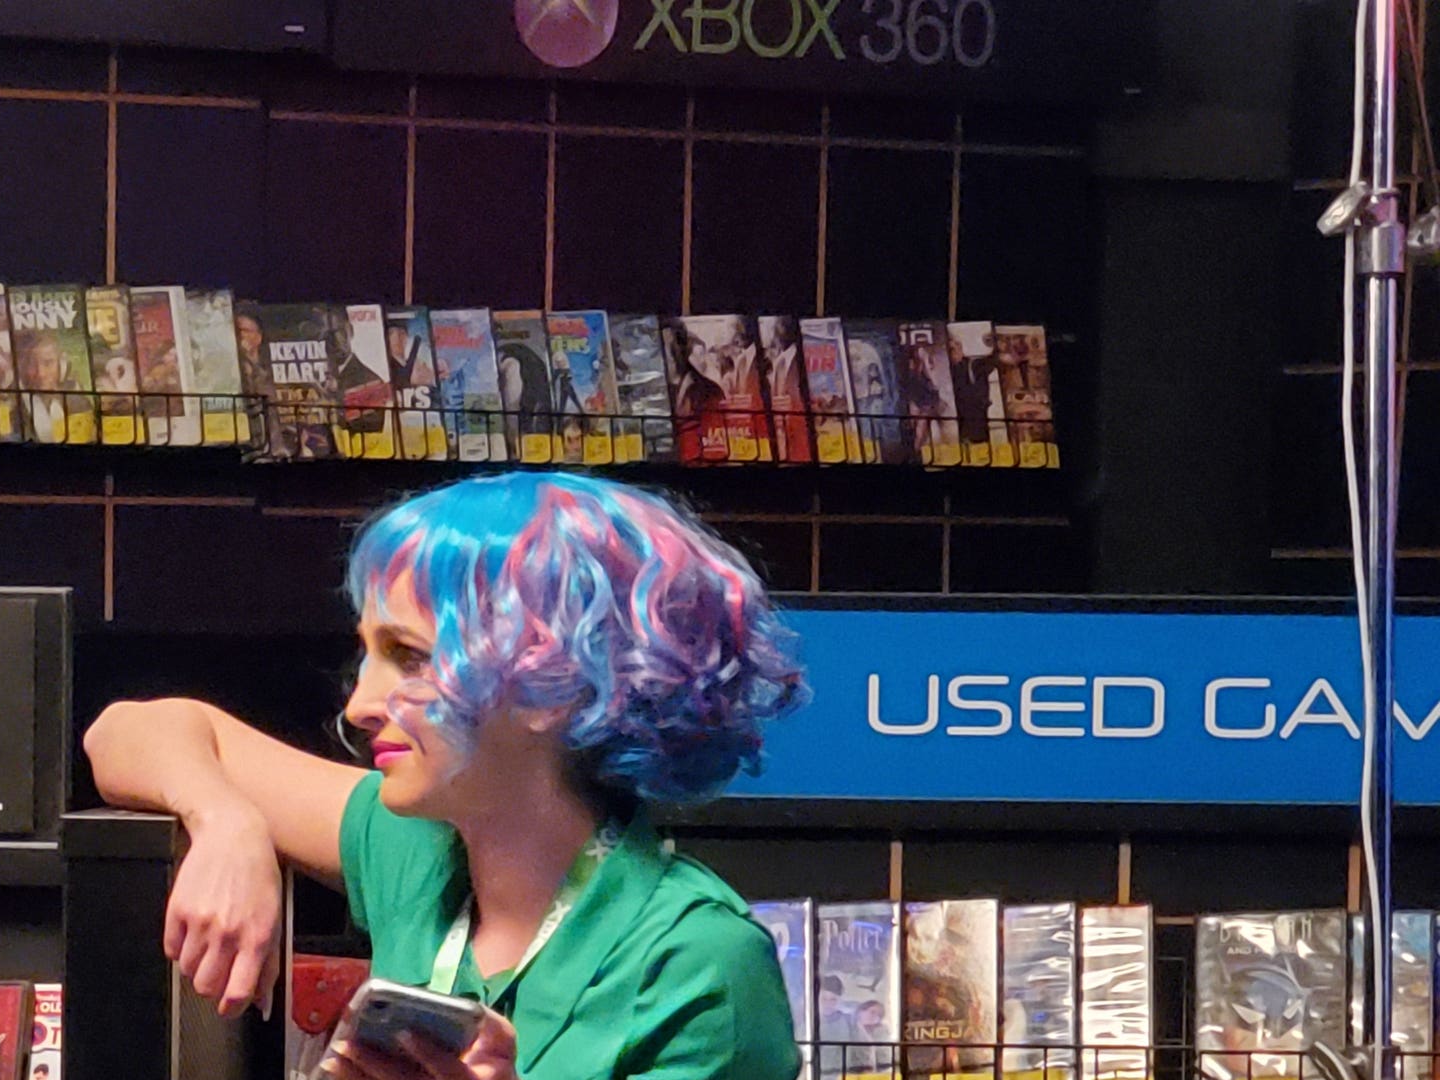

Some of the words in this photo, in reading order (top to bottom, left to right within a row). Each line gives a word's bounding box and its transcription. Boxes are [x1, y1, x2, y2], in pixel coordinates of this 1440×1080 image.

[634, 0, 846, 60] XBOX
[861, 0, 996, 67] 360
[269, 341, 327, 360] KEVIN
[271, 362, 328, 384] HART
[396, 385, 432, 409] rs
[867, 673, 1166, 738] USED
